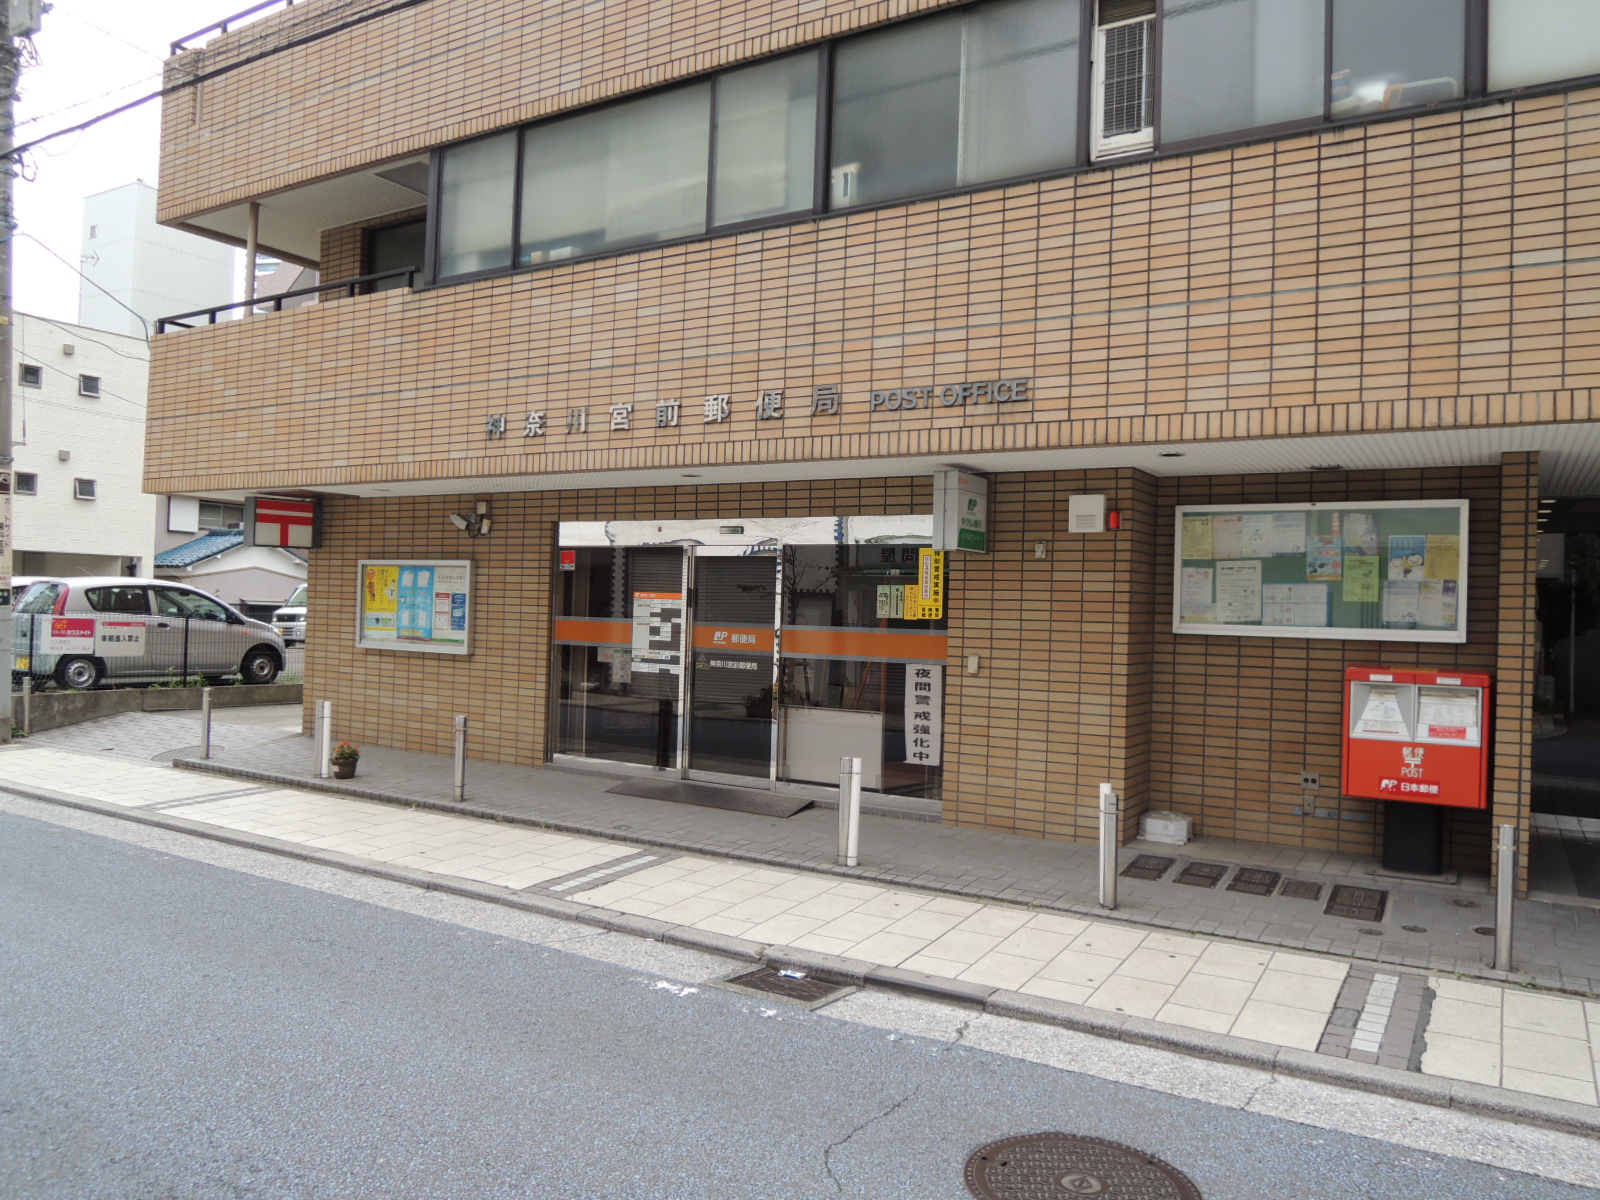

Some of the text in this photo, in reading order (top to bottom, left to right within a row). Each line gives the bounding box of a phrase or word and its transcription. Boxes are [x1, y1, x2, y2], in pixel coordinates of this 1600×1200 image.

[870, 378, 1029, 412] POST OFFICE
[486, 383, 840, 441] 神奈川宮前郵便局
[731, 633, 756, 644] 郵便局
[709, 659, 758, 670] 神奈川宮前郵便局
[913, 668, 932, 762] 夜間警戒強化中
[1402, 746, 1424, 759] 郵便
[1401, 766, 1424, 778] POST
[1401, 782, 1440, 795] 日本郵便
